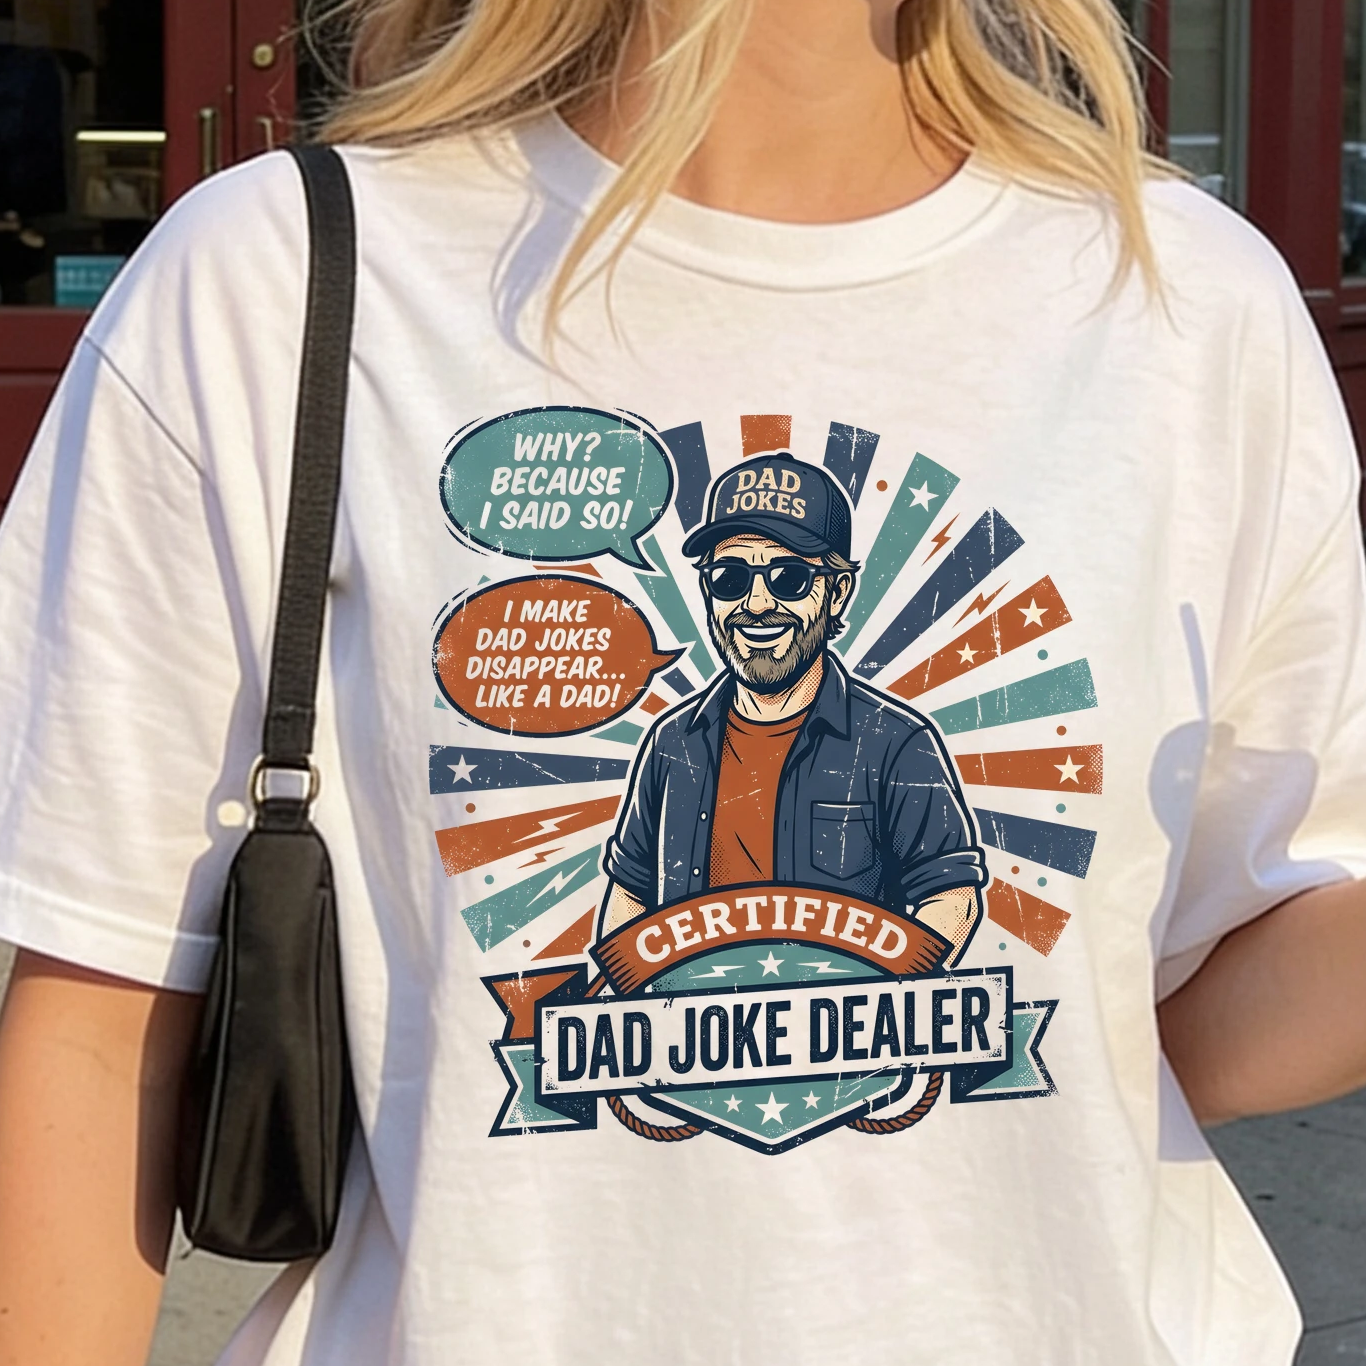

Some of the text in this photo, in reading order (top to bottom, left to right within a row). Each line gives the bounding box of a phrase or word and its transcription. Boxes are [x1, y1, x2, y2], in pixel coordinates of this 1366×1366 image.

[513, 432, 602, 462] WHY?
[490, 466, 626, 495] BECAUSE
[736, 467, 801, 494] DAD
[479, 499, 634, 530] I SAID SO!
[726, 491, 807, 519] JOKES
[503, 599, 592, 623] I MAKE
[475, 628, 611, 651] DAD JOKES
[465, 656, 626, 680] DISAPPEAR...
[475, 683, 621, 708] LIKE A DAD!
[635, 895, 909, 963] CERTIFIED
[557, 986, 991, 1082] DAD JOKE DEALER
